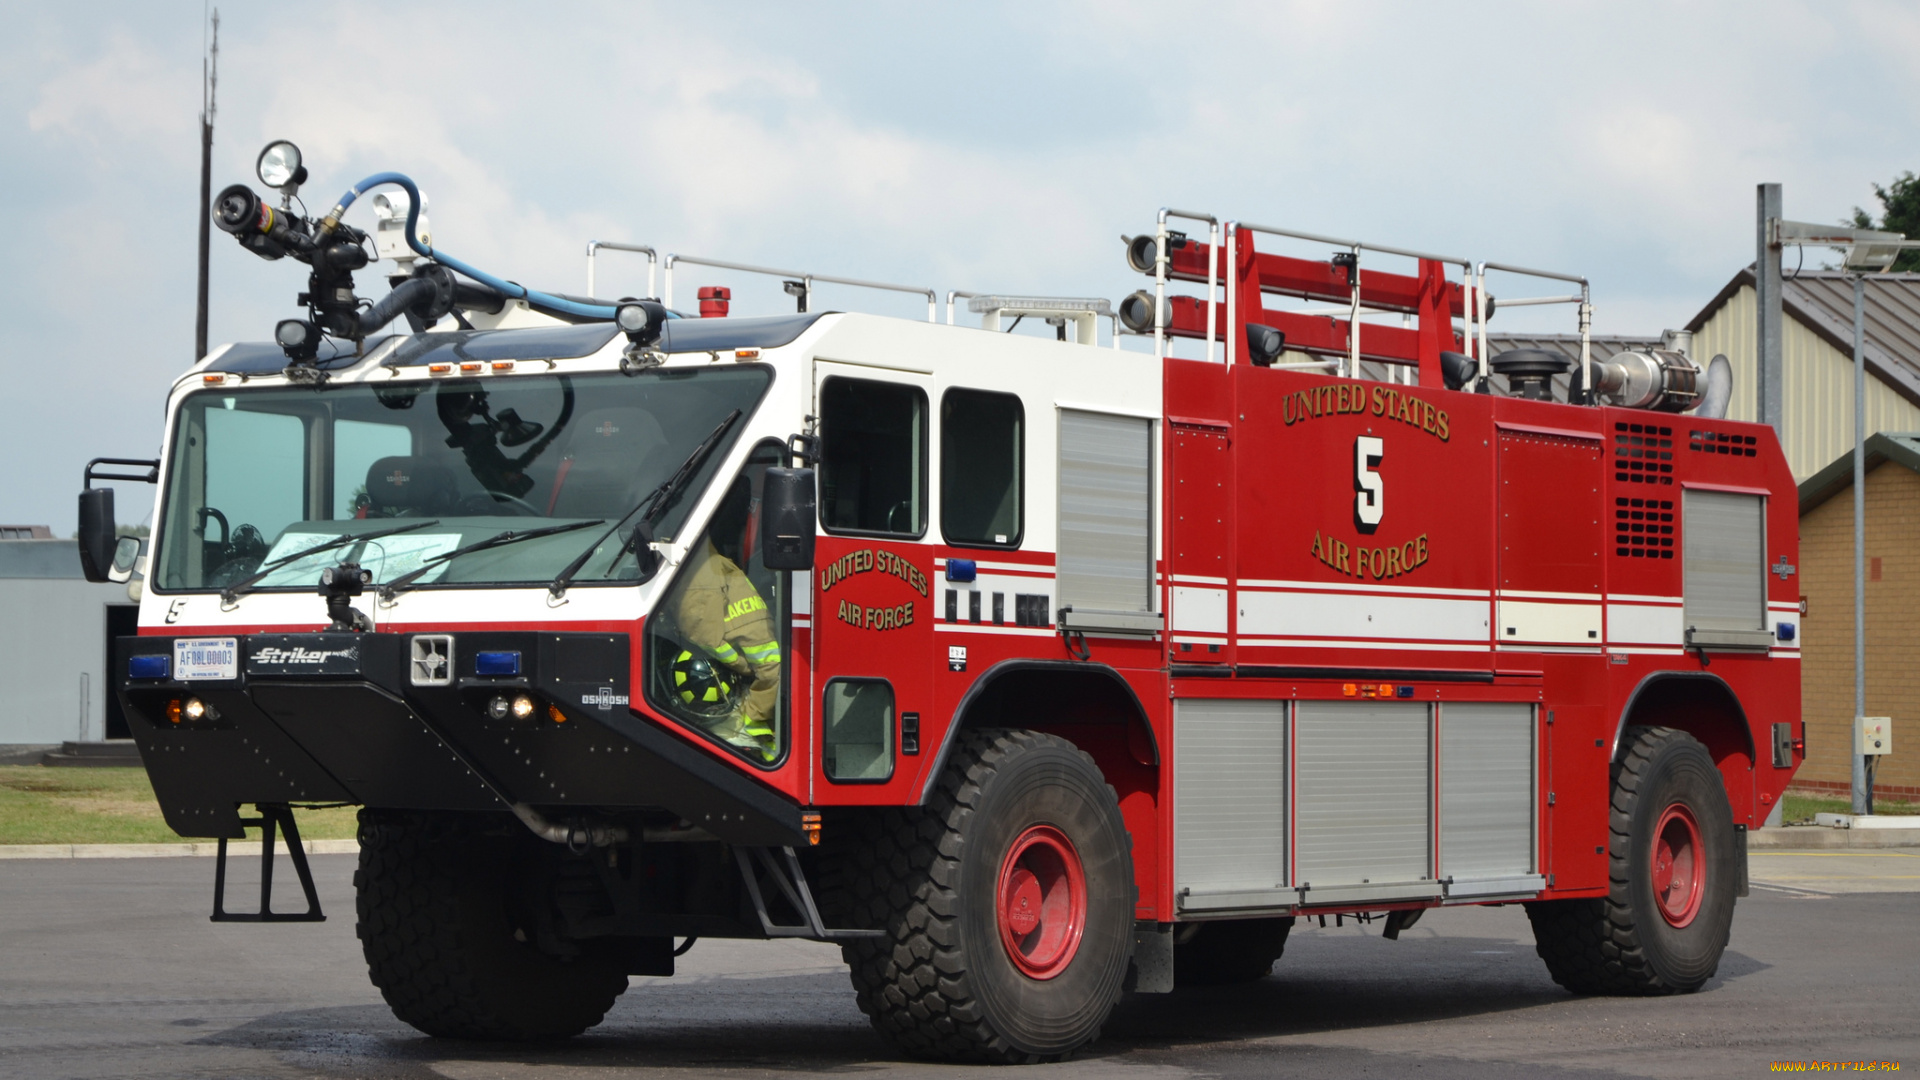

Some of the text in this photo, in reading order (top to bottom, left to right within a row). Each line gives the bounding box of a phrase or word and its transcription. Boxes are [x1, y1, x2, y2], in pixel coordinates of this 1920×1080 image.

[1282, 384, 1450, 442] UNITED STATES
[1353, 435, 1383, 535] 5
[822, 549, 928, 598] UNITED STATES
[1311, 529, 1429, 580] AIR FORCE
[165, 597, 189, 624] 5
[838, 599, 914, 631] AIR FORCE
[250, 647, 331, 664] Striker
[582, 691, 629, 706] OSHKOSH
